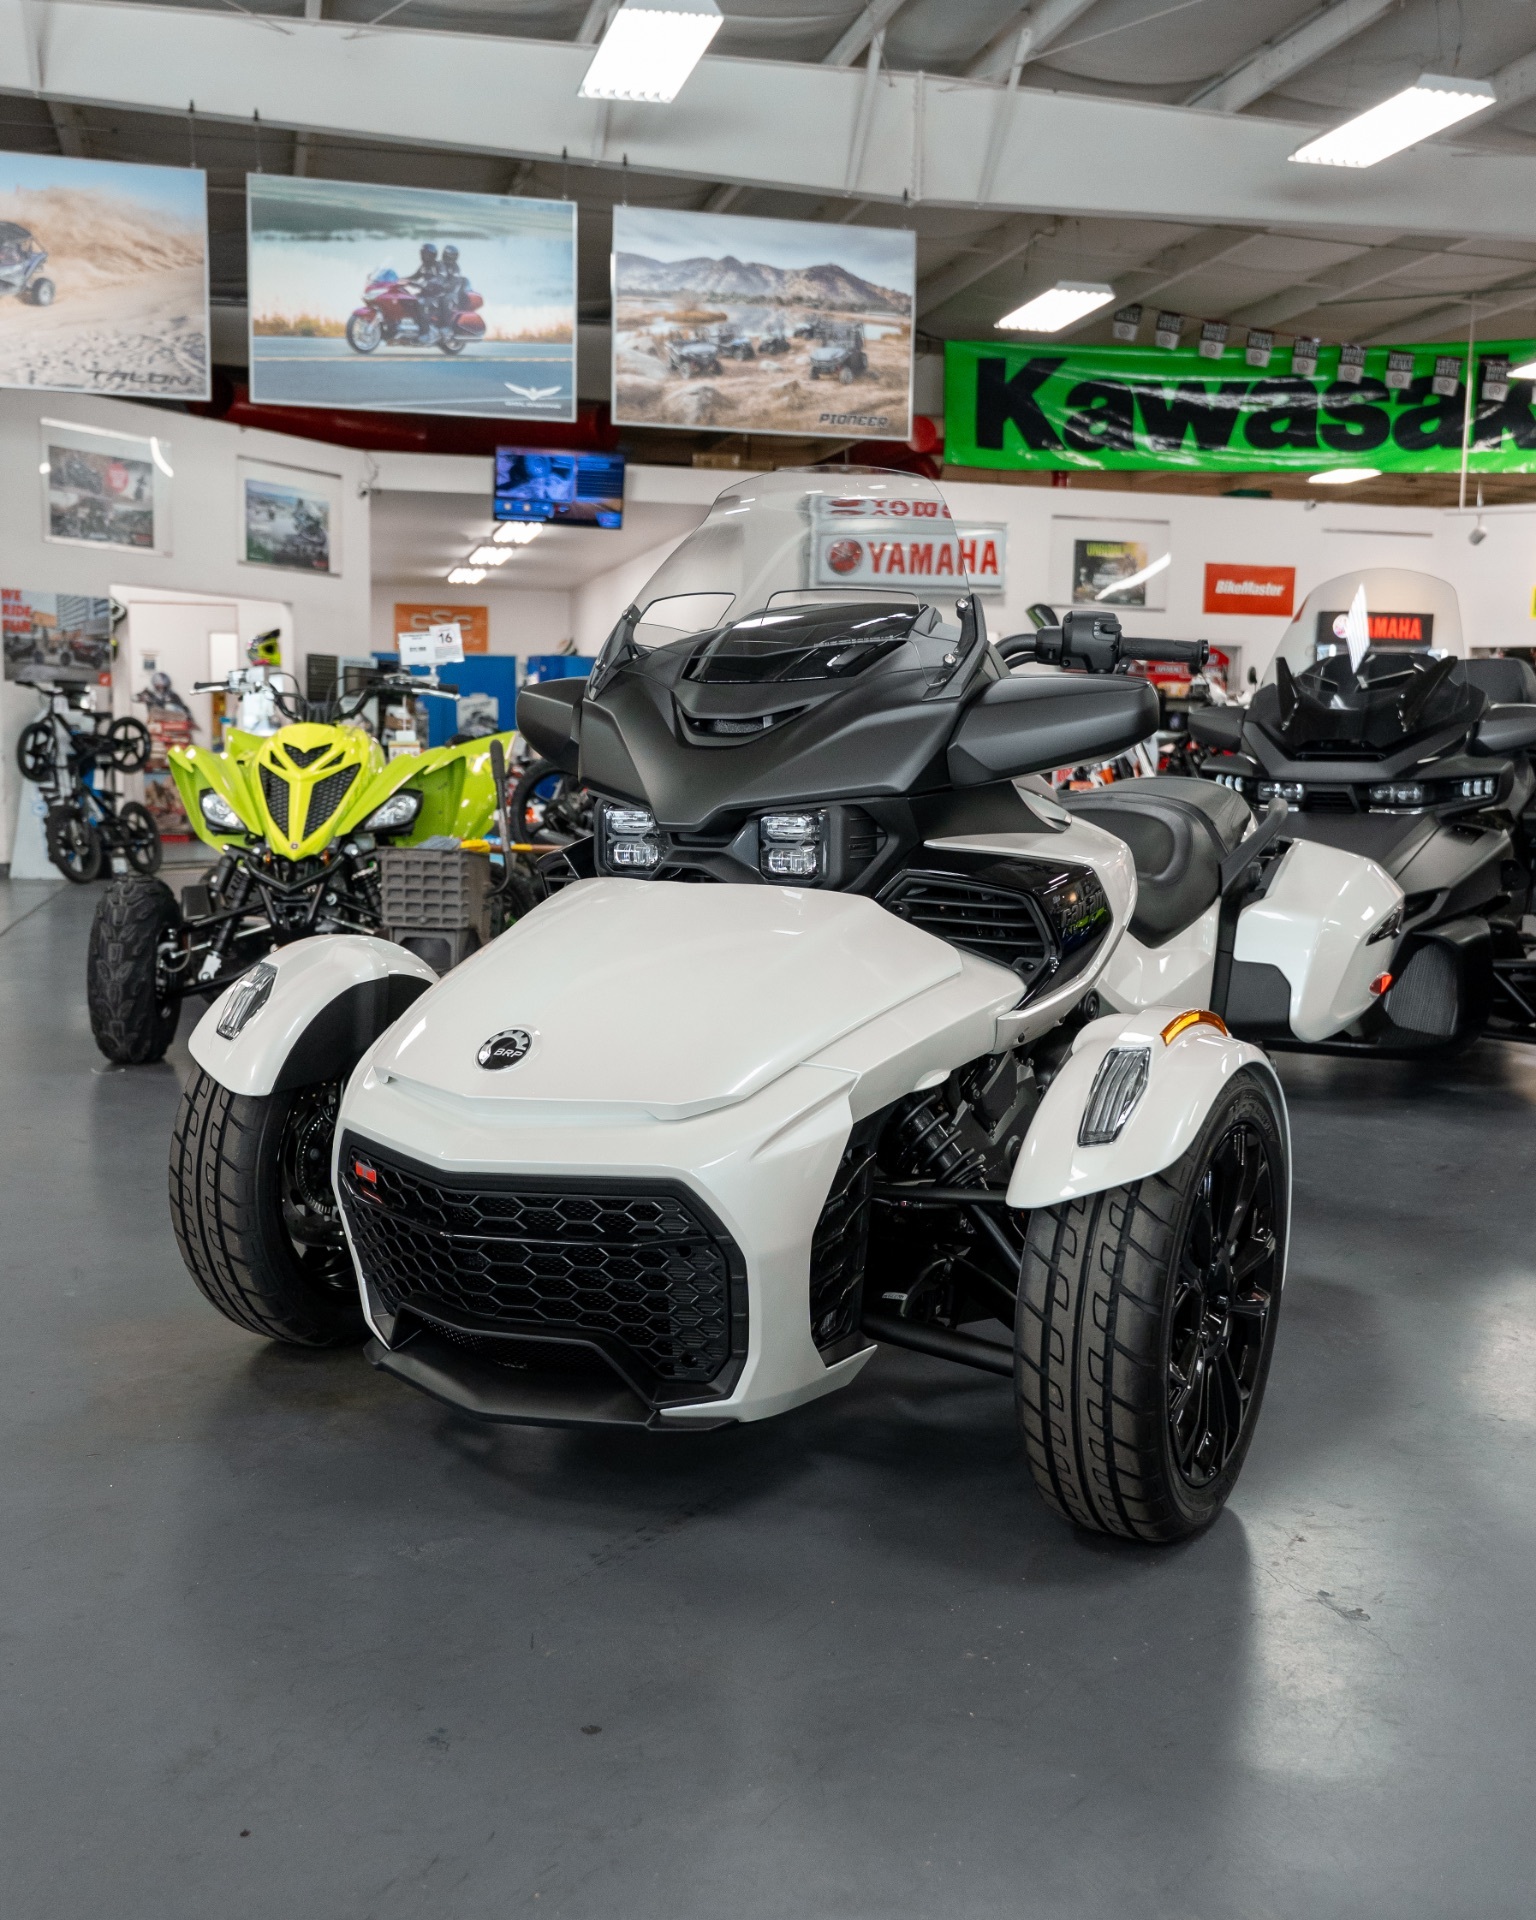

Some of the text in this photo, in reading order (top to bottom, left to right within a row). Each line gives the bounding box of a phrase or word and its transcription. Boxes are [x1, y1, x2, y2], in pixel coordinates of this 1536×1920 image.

[87, 369, 192, 386] TALON
[818, 413, 889, 429] PIONEER
[866, 538, 999, 577] YAMAHA
[1215, 579, 1285, 597] BikeMaster
[438, 633, 453, 644] 16
[493, 1047, 524, 1058] BRP
